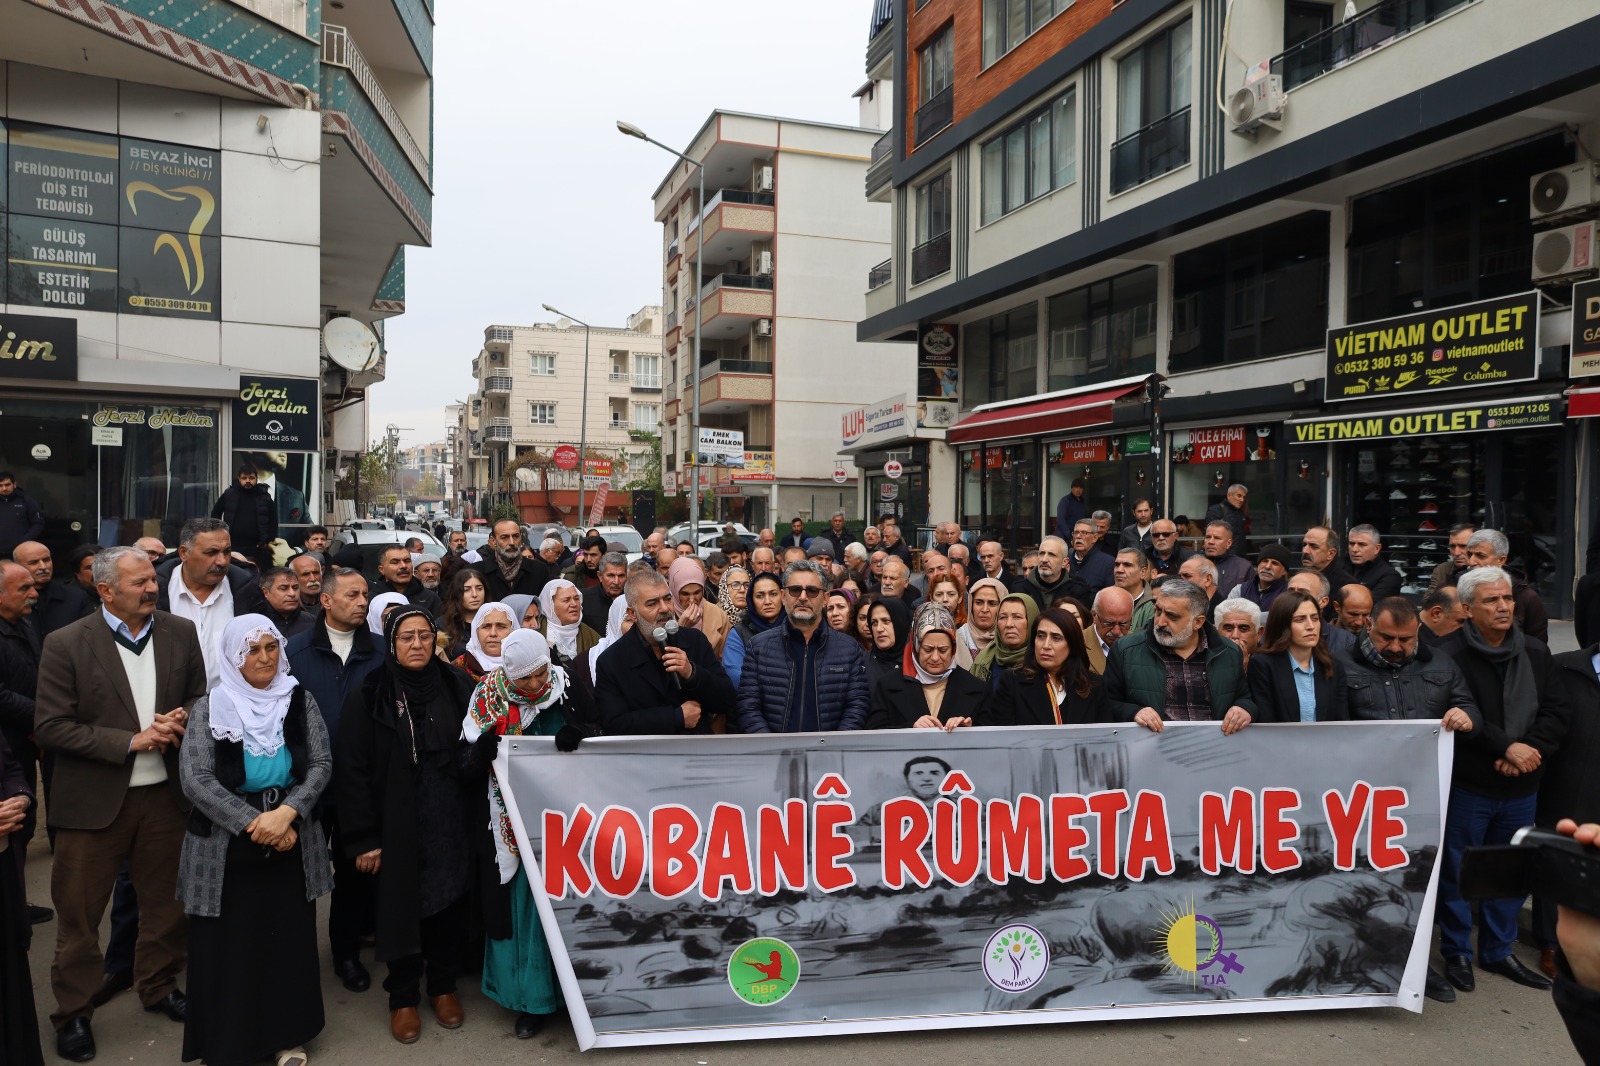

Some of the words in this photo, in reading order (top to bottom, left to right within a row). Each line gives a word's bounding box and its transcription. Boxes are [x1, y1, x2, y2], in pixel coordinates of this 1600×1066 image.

[130, 147, 179, 164] BEYAZ
[183, 152, 213, 169] İNCİ
[14, 160, 114, 185] PERİODONTOLOJİ
[143, 162, 160, 176] DİŞ
[41, 181, 67, 197] (DİŞ
[70, 185, 88, 198] ETİ
[35, 197, 94, 216] TEDAVİSİ)
[43, 227, 86, 248] GÜLÜŞ
[31, 246, 97, 265] TASARIMI
[38, 271, 90, 289] ESTETİK
[42, 289, 85, 305] DOLGU
[144, 298, 166, 308] 0553
[168, 300, 184, 309] 309
[186, 302, 197, 310] 84
[198, 303, 208, 311] 70
[1334, 330, 1425, 358] VİETNAM
[1431, 305, 1528, 342] OUTLET
[0, 325, 57, 361] im
[1446, 336, 1525, 360] vietnamoutlett
[1344, 359, 1369, 374] 0532
[1371, 356, 1391, 370] 380
[1393, 353, 1408, 367] 59
[1410, 351, 1424, 365] 36
[1425, 365, 1458, 376] Reebok
[1397, 371, 1417, 382] NIKE
[1463, 369, 1507, 381] Columbia
[240, 383, 288, 401] Terzi
[1343, 385, 1366, 395] PUMA
[246, 398, 308, 416] Nedim
[1487, 406, 1509, 417] 0553
[1509, 405, 1526, 415] 307
[1527, 404, 1538, 413] 12
[1538, 403, 1550, 412] 05
[93, 406, 146, 427] Terzi
[148, 408, 214, 429] Nedim
[1389, 409, 1482, 435] OUTLET
[716, 438, 742, 446] BALKON
[1213, 431, 1219, 442] &
[1221, 427, 1244, 442] FIRAT
[753, 453, 773, 461] EMLAK
[1073, 451, 1084, 460] ÇAY
[1085, 448, 1095, 459] EVİ
[1200, 446, 1215, 462] ÇAY
[1217, 442, 1231, 458] EVİ
[541, 772, 857, 902] KOBANÊ
[880, 770, 1176, 889] RÛMETA
[1199, 785, 1302, 876] ME
[1321, 779, 1410, 872] YE
[1001, 978, 1014, 987] DEM
[1201, 973, 1227, 985] TJA
[751, 984, 777, 995] DBP
